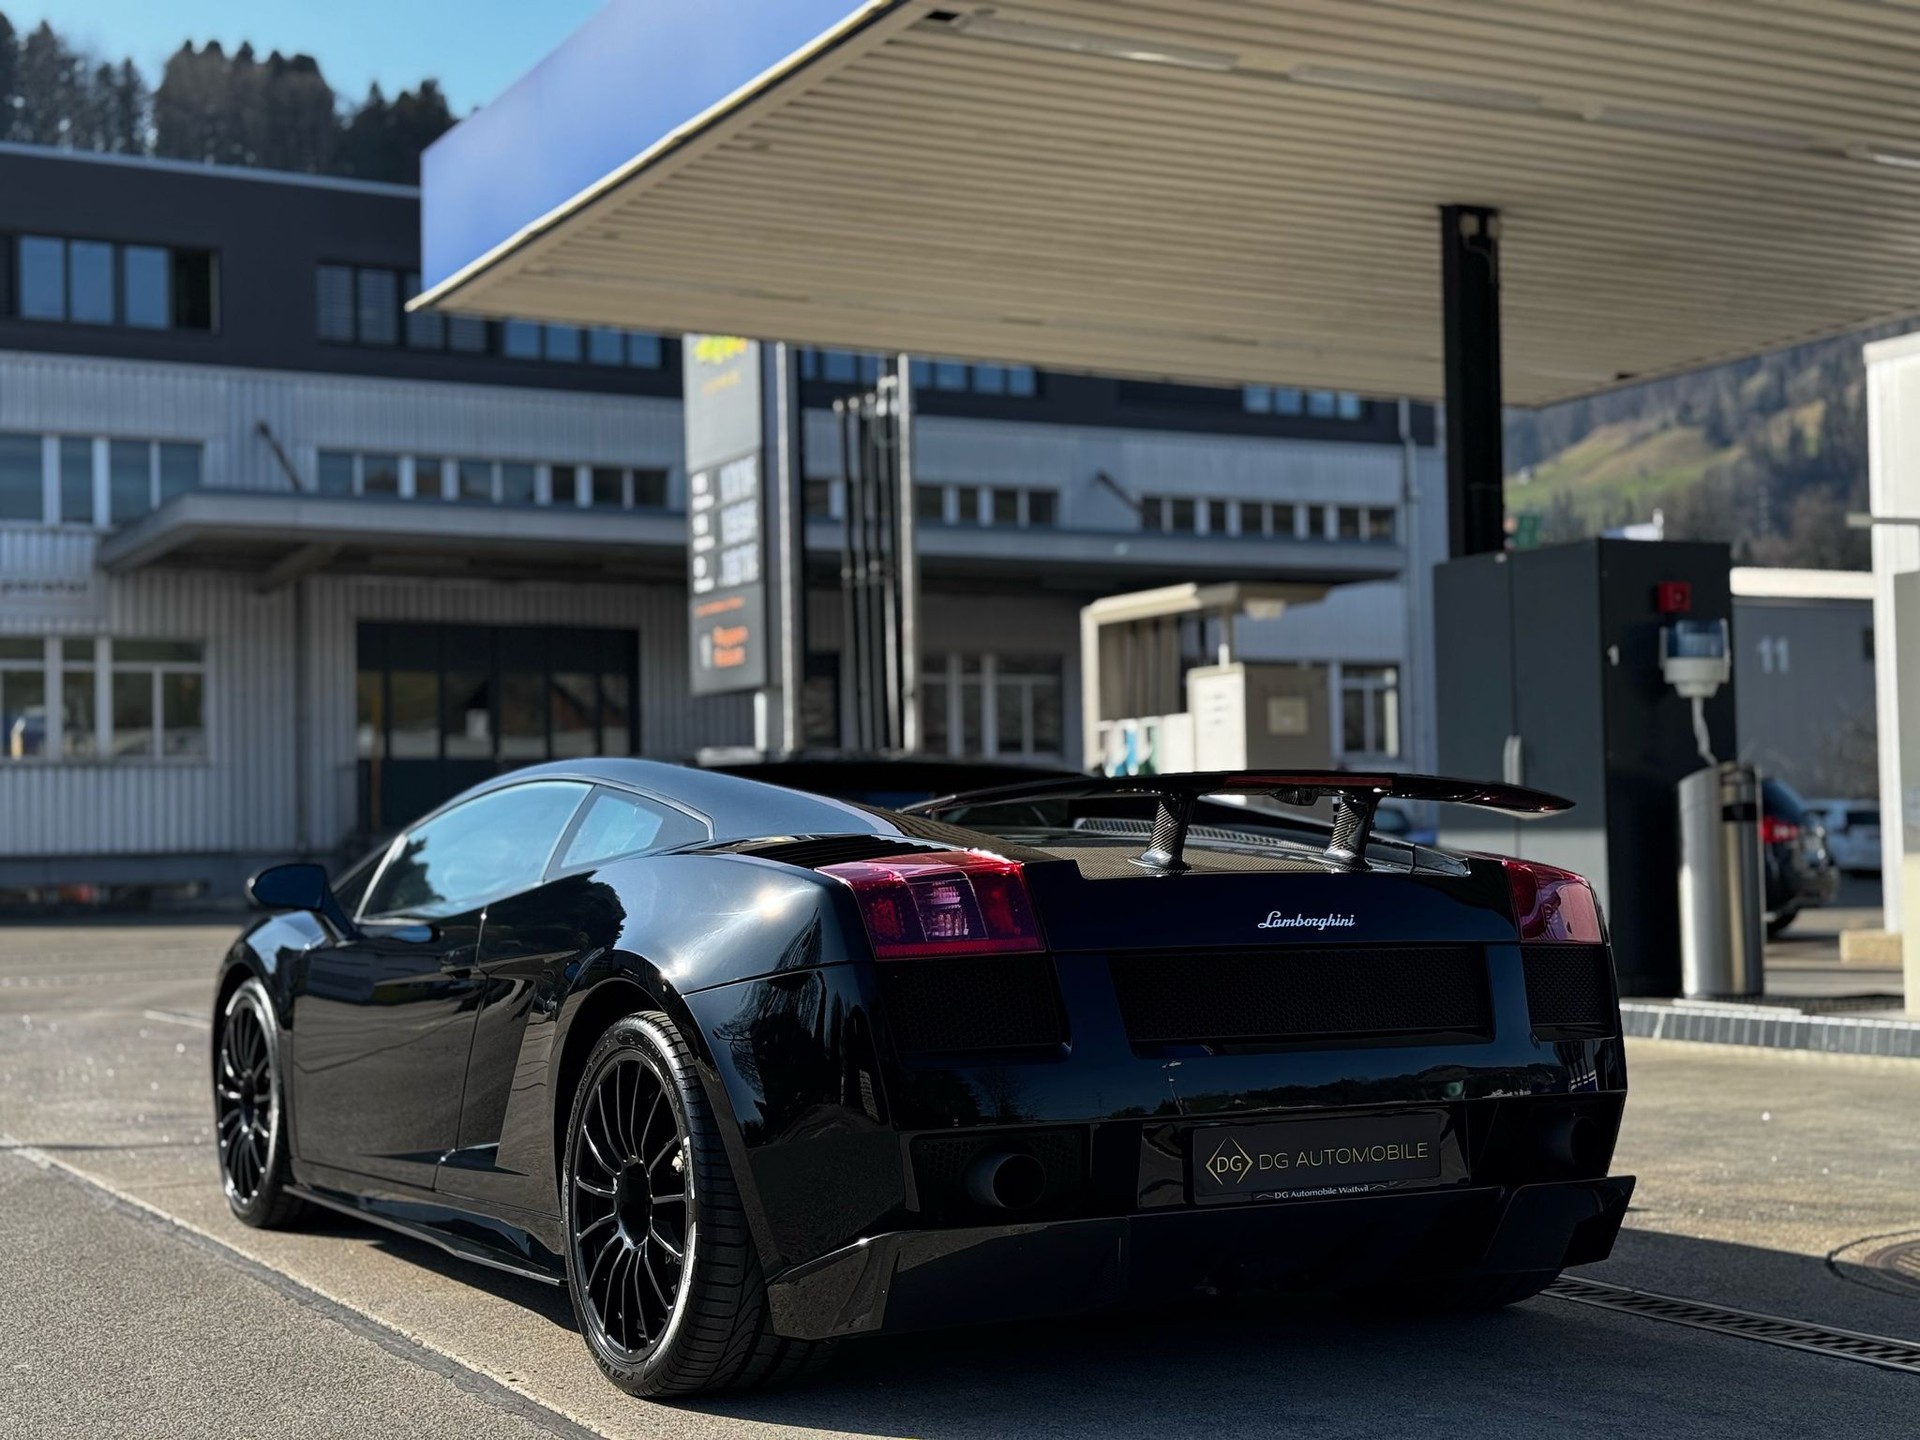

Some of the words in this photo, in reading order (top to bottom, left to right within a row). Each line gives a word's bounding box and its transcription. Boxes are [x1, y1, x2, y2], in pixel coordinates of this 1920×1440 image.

[1756, 636, 1788, 674] 11
[1257, 910, 1355, 930] Lamborghini
[1216, 1155, 1242, 1173] DG
[1259, 1152, 1289, 1170] DG
[1295, 1142, 1428, 1168] AUTOMOBILE
[1274, 1191, 1289, 1199] DG
[1290, 1187, 1337, 1198] Automobile
[1338, 1184, 1369, 1195] Wattwil
